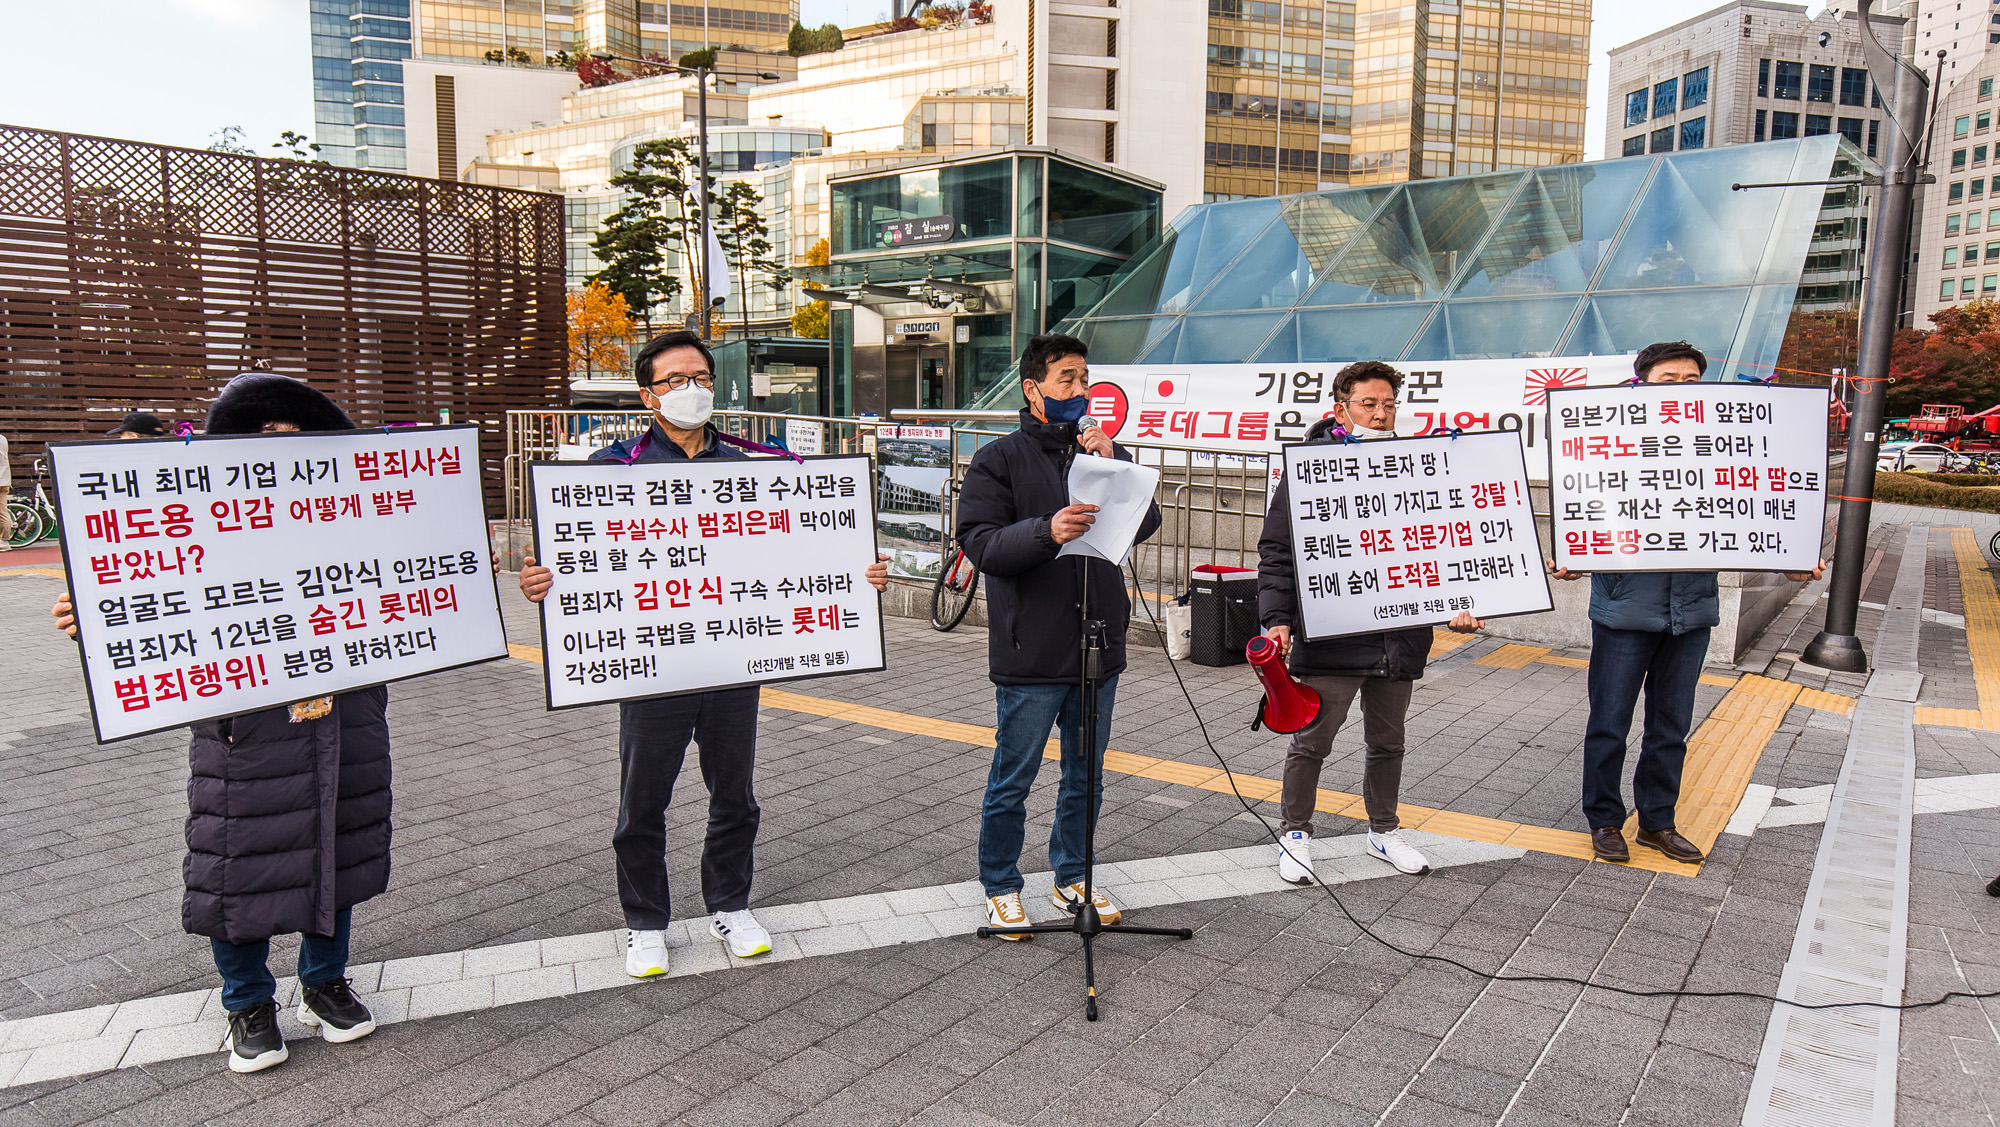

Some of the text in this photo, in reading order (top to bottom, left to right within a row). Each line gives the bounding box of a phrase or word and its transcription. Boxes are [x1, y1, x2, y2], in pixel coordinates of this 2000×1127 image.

[1137, 410, 1306, 442] 롯데그룹은
[1561, 400, 1771, 428] 일본기업 롯데 앞잡이
[1563, 436, 1682, 460] 매국노들은
[78, 446, 461, 500] 국내 최대 기업 사기 범죄사실
[1297, 458, 1359, 484] 대한민국
[1368, 454, 1414, 478] 노른자
[1564, 466, 1819, 493] 이나라 국민이 피와 땀으로
[552, 485, 635, 507] 대한민국
[769, 474, 855, 501] 수사관을
[1300, 496, 1347, 521] 그렇게
[1355, 493, 1386, 518] 많이
[1394, 490, 1442, 514] 가지고
[1449, 489, 1465, 508] 또
[85, 489, 416, 543] 매도용 인감 어떻게 발부
[1563, 497, 1795, 521] 모은 재산 수천억이 매년
[554, 509, 855, 543] 모두 부실수사 범죄은폐 막이에
[1304, 519, 1512, 561] 롯데는 위조 전문기업 인가
[1566, 529, 1786, 555] 일본땅으로 가고 있다.
[91, 545, 204, 584] 받았나?
[556, 545, 706, 574] 동원 할 수 없다
[99, 591, 190, 627] 얼굴도
[204, 578, 283, 610] 모르는
[394, 551, 478, 583] 인감도용
[560, 590, 623, 615] 범죄자
[777, 573, 852, 598] 수사하라
[1309, 572, 1340, 598] 뒤에
[1348, 569, 1379, 595] 숨어
[1388, 561, 1440, 589] 도적질
[1374, 596, 1474, 620] (선진개발 직원 일동)
[106, 584, 458, 669] 범죄자 12년을 숨긴 롯데의
[564, 604, 859, 654] 이나라 국법을 무시하는 롯데는
[114, 627, 436, 712] 범죄행위! 분명 밝혀진다
[566, 655, 657, 685] 각성하라!
[748, 651, 849, 674] (선진개발 직원 일동)
